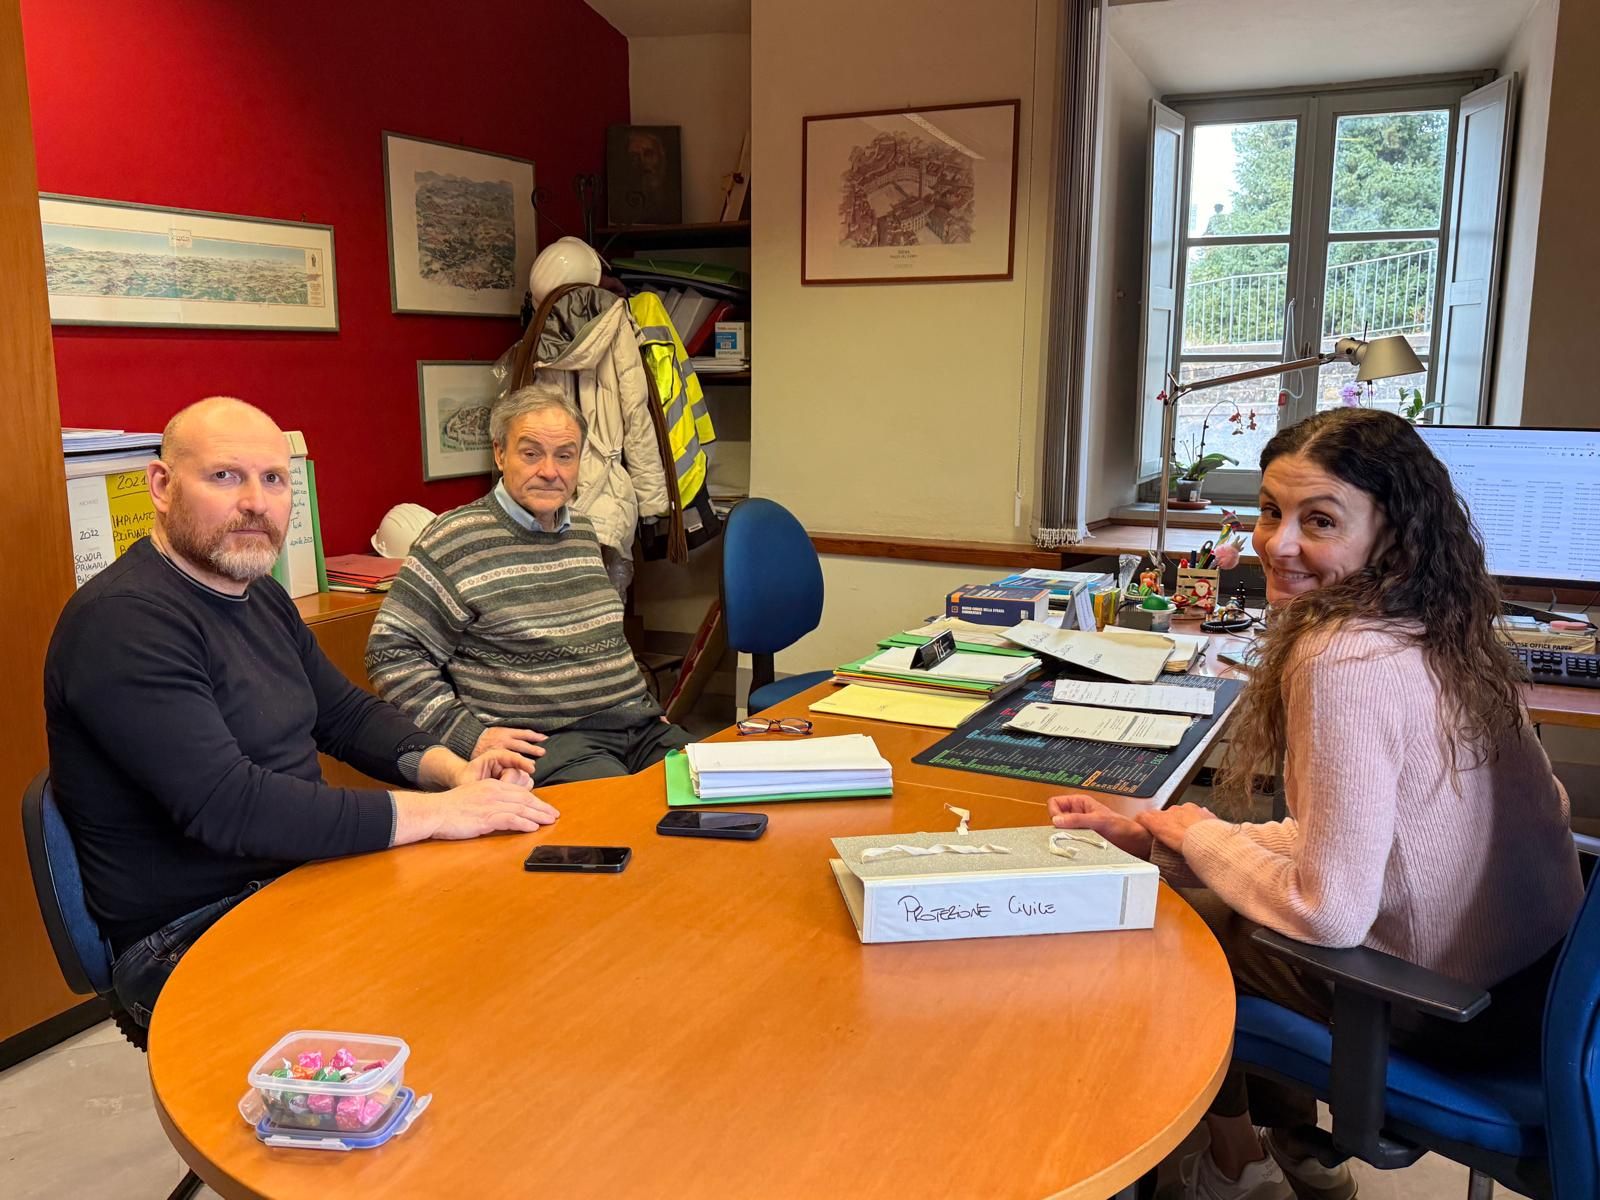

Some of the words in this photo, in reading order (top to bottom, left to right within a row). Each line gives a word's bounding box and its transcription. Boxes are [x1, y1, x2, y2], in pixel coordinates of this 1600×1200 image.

[117, 475, 148, 490] 2021
[79, 529, 100, 541] 2022
[74, 552, 102, 565] SCUOLA
